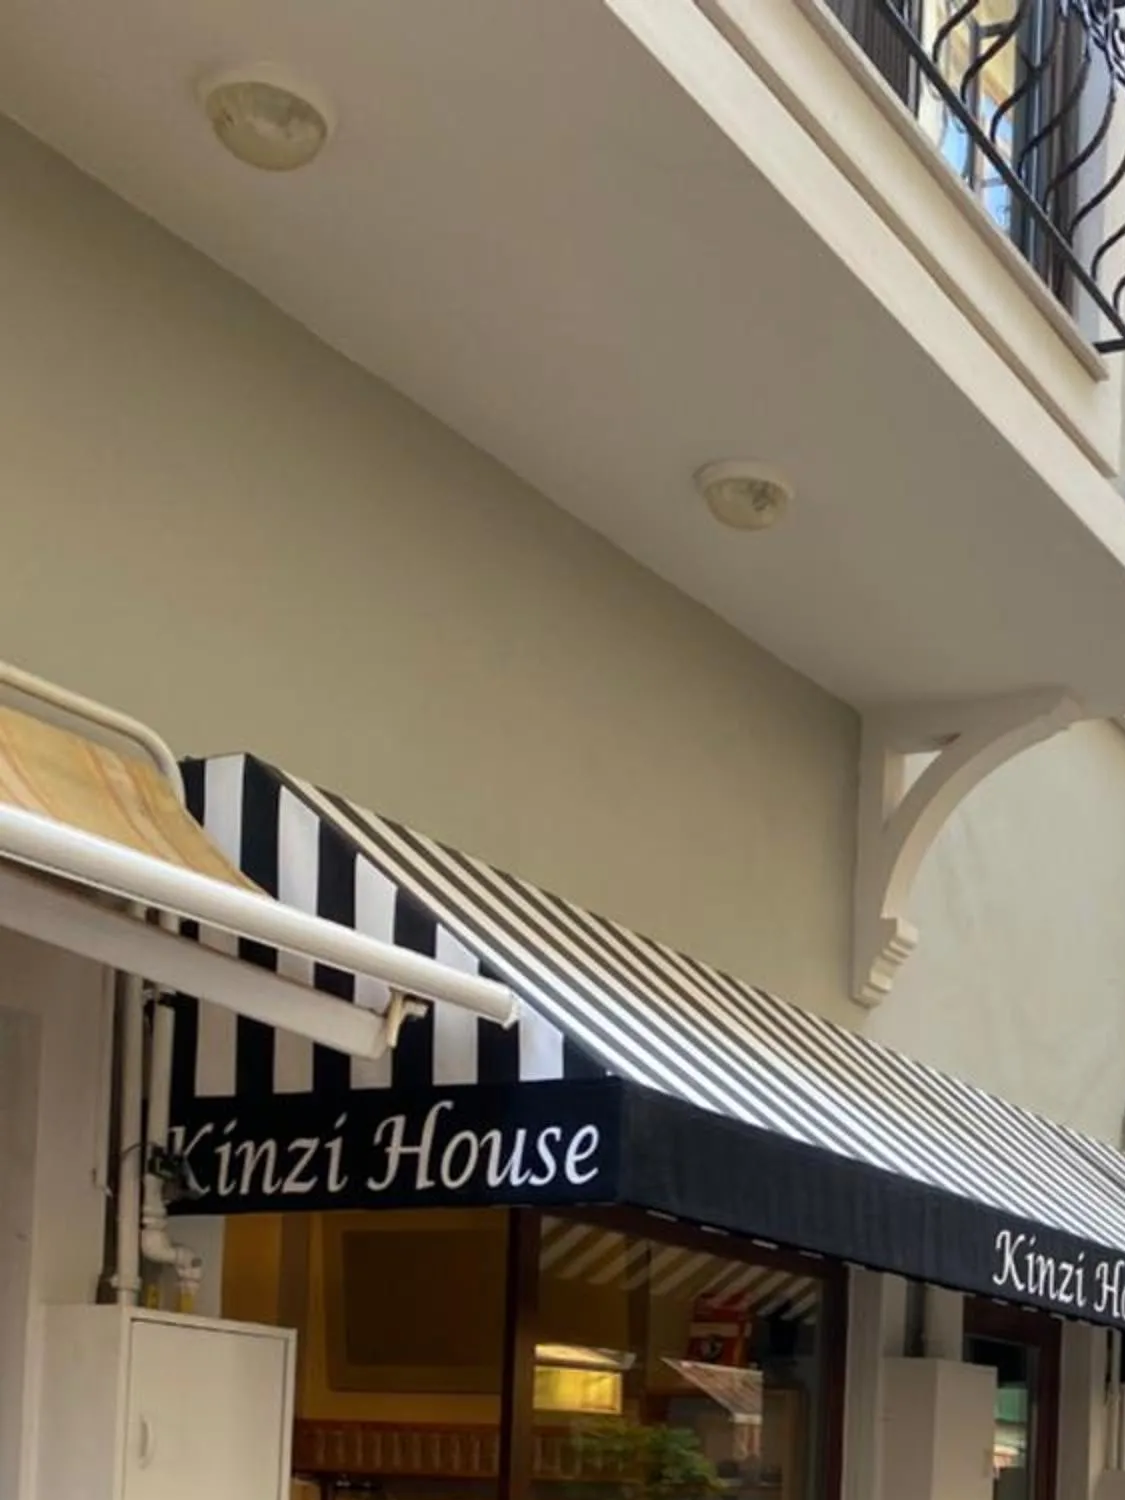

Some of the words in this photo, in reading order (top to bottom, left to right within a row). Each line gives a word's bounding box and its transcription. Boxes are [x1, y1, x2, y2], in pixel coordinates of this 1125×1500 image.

[167, 1112, 348, 1196] Kinzi
[367, 1100, 599, 1190] House
[992, 1229, 1087, 1308] Kinzi
